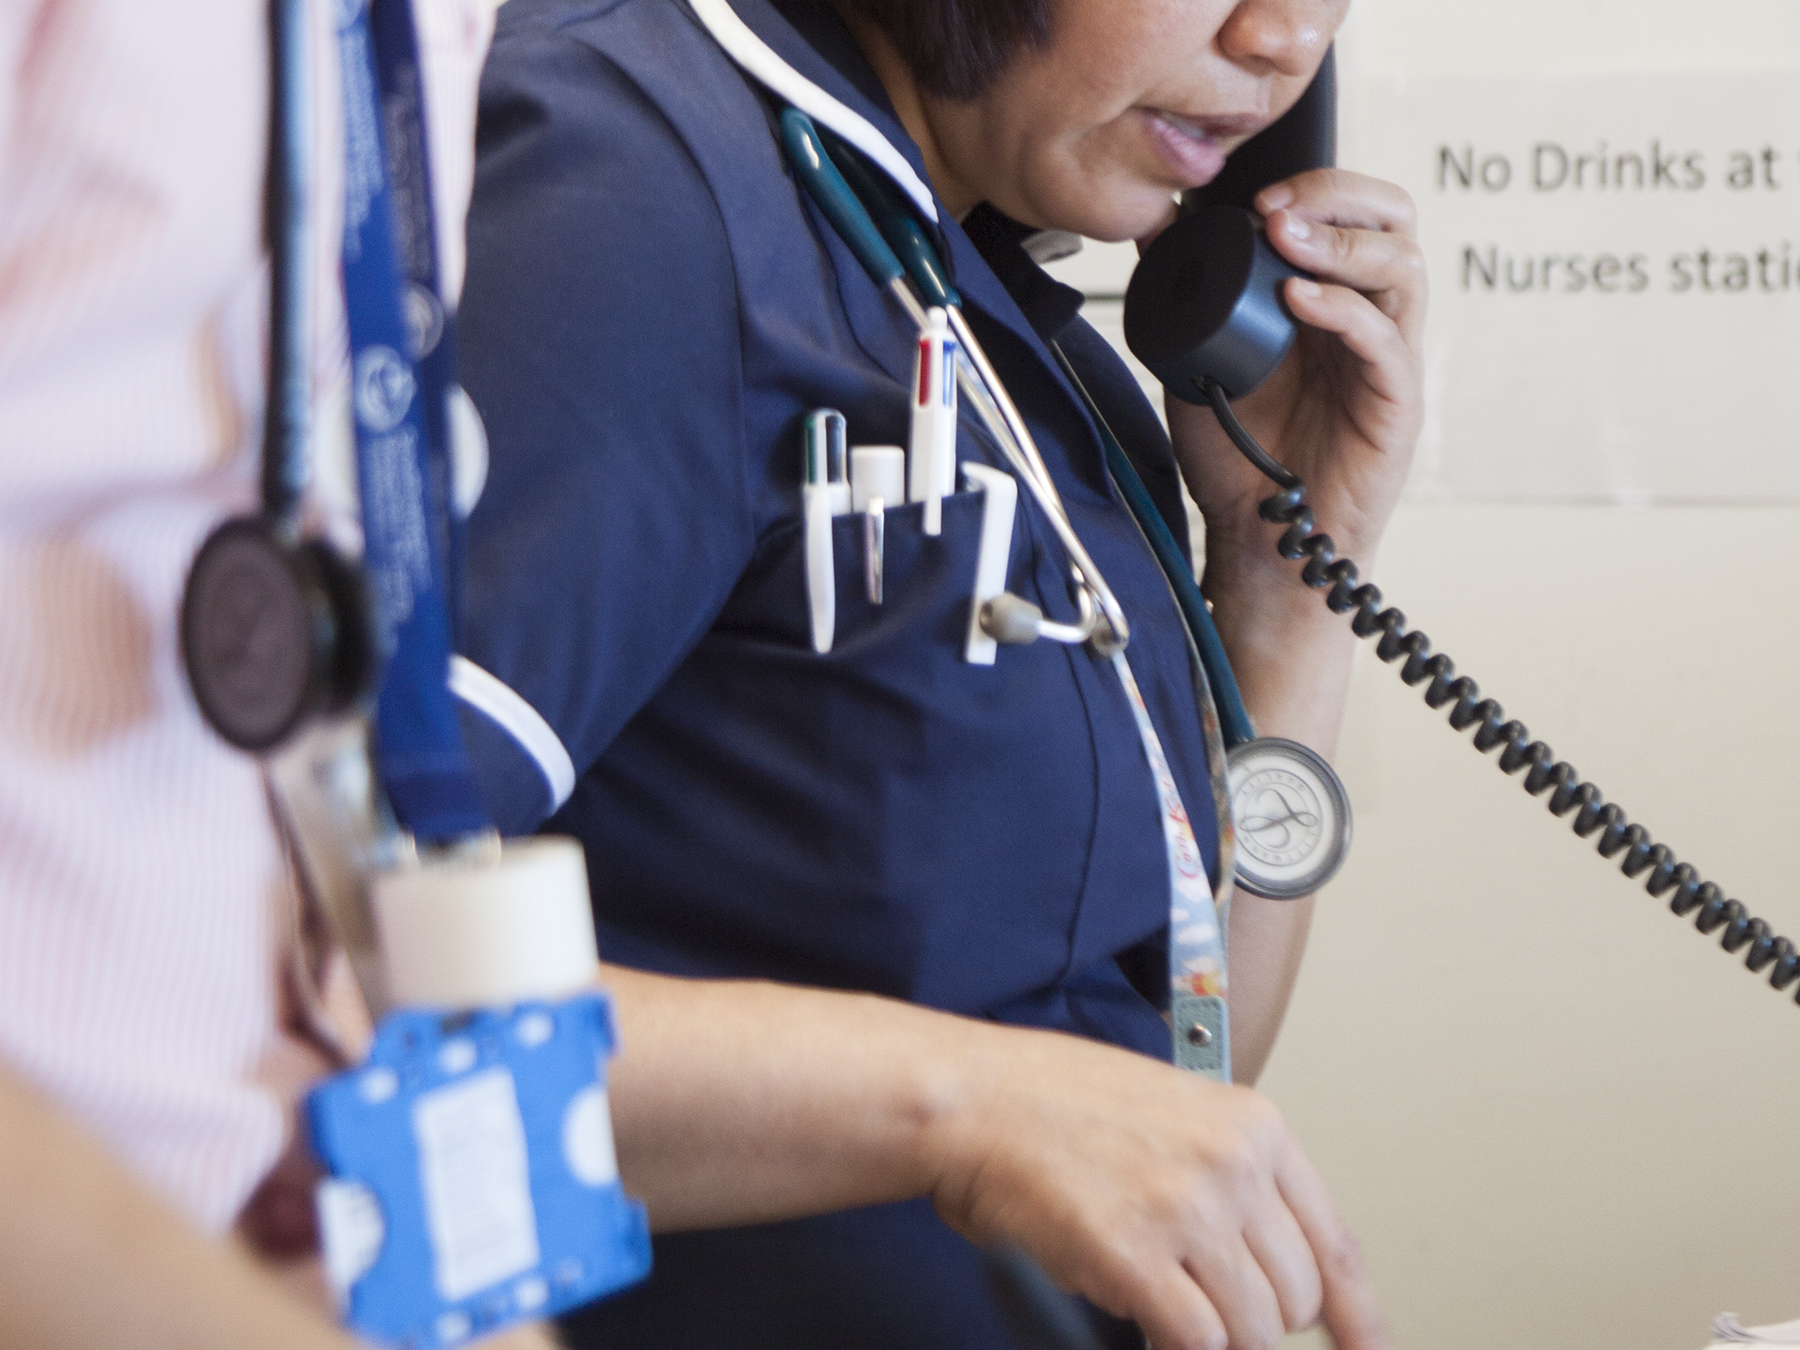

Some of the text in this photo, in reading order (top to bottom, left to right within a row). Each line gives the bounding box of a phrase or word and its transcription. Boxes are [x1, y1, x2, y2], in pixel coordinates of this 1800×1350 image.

[1437, 144, 1512, 191] No
[1533, 138, 1706, 191] Drinks
[1728, 145, 1780, 190] at
[1463, 241, 1800, 293] Nurses stati
